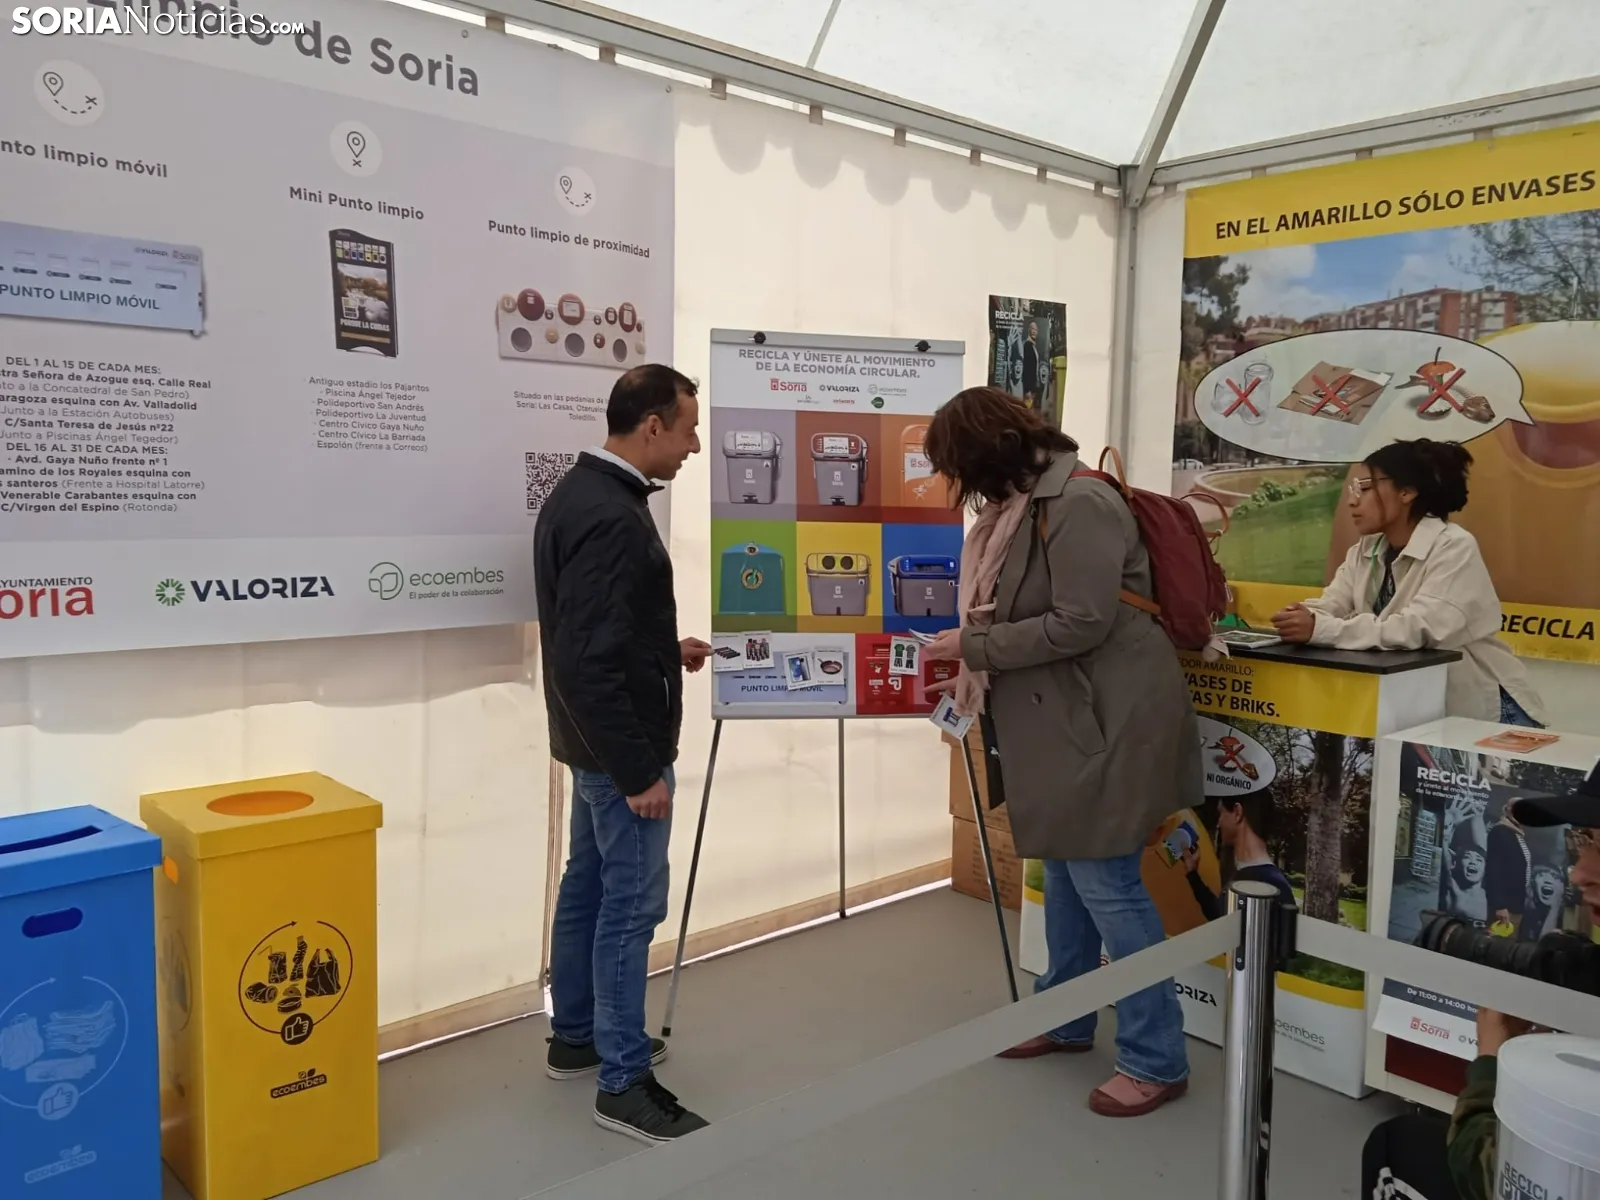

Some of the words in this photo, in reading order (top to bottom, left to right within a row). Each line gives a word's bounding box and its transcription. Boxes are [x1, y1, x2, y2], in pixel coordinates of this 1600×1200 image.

[295, 20, 351, 65] de
[370, 37, 479, 96] Soria
[1, 140, 36, 156] nto
[44, 145, 108, 168] limpio
[116, 158, 168, 178] móvil
[290, 187, 322, 203] Mini
[328, 193, 373, 211] Punto
[378, 201, 424, 220] limpio
[1216, 220, 1241, 239] EN
[1247, 217, 1270, 234] EL
[1275, 200, 1391, 231] AMARILLO
[1398, 189, 1464, 215] SÓLO
[1472, 169, 1596, 205] ENVASES
[488, 220, 526, 236] Punto
[530, 227, 570, 243] limpio
[574, 234, 589, 245] de
[593, 238, 650, 258] proximidad
[0, 284, 54, 300] PUNTO
[60, 290, 111, 305] LIMPIO
[116, 294, 160, 310] MÓVIL
[995, 310, 1024, 321] RECICLA
[6, 357, 30, 366] DEL
[44, 360, 59, 368] AL
[63, 360, 74, 368] 15
[79, 361, 94, 370] DE
[99, 363, 131, 372] CADA
[135, 365, 161, 374] MES:
[739, 349, 789, 360] RECICLA
[793, 352, 800, 360] Y
[804, 351, 842, 363] ÚNETE
[845, 355, 860, 364] AL
[864, 356, 935, 367] MOVIMIENTO
[756, 362, 772, 371] DE
[775, 363, 790, 372] LA
[794, 364, 856, 375] ECONOMÍA
[860, 367, 920, 378] CIRCULAR.
[22, 370, 64, 380] Señora
[68, 373, 82, 381] de
[86, 374, 128, 384] Azogue
[132, 378, 154, 386] esq.
[158, 378, 185, 387] Calle
[189, 380, 211, 388] Real
[309, 377, 344, 387] Antiguo
[347, 380, 378, 388] estadio
[380, 381, 392, 389] los
[780, 382, 807, 392] Soria
[29, 382, 39, 391] la
[43, 383, 110, 395] Concatedral
[131, 388, 150, 396] San
[155, 389, 189, 399] Pedro)
[325, 389, 355, 397] Piscina
[386, 392, 415, 401] Tejedor
[51, 397, 95, 405] esquina
[144, 400, 197, 410] Valladolid
[317, 398, 375, 408] Polideportivo
[378, 402, 393, 410] San
[395, 403, 424, 411] Andrés
[1, 406, 34, 415] Junto
[49, 408, 58, 416] la
[62, 408, 109, 418] Estación
[113, 410, 174, 421] Autobuses)
[316, 409, 373, 419] Polideportivo
[389, 413, 426, 421] Juventud
[5, 418, 53, 428] C/Santa
[57, 420, 94, 429] Teresa
[98, 422, 112, 430] de
[116, 422, 146, 431] Jesús
[319, 420, 348, 428] Centro
[380, 423, 400, 431] Gaya
[47, 431, 91, 440] Piscinas
[131, 434, 178, 444] Tegedor)
[318, 430, 348, 438] Centro
[6, 443, 31, 451] DEL
[51, 444, 67, 452] AL
[70, 444, 81, 452] 31
[106, 445, 138, 453] CADA
[142, 446, 168, 454] MES:
[317, 441, 352, 449] Espolón
[355, 442, 384, 450] (frente
[15, 455, 41, 464] Avd.
[46, 456, 75, 465] Gaya
[79, 456, 108, 464] Nuño
[112, 457, 145, 465] frente
[40, 467, 54, 475] de
[79, 468, 122, 477] Royales
[126, 469, 168, 478] esquina
[62, 480, 103, 488] (Frente
[116, 481, 160, 489] Hospital
[164, 481, 205, 490] Latorre)
[0, 491, 60, 499] Venerable
[65, 492, 128, 500] Carabantes
[132, 492, 174, 500] esquina
[1, 503, 55, 512] C/Virgen
[60, 503, 77, 511] del
[82, 504, 119, 512] Espino
[123, 503, 177, 512] (Rotonda)
[0, 577, 93, 588] YUNTAMIENTO
[410, 567, 504, 586] ecoembes
[191, 576, 335, 602] VALORIZA
[418, 591, 439, 599] poder
[442, 589, 450, 597] de
[452, 589, 458, 597] la
[461, 588, 503, 596] colaboración
[0, 587, 94, 619] oria
[1500, 614, 1594, 640] RECICLA
[1204, 661, 1254, 676] AMARILLO:
[1185, 673, 1226, 690] ASES
[1232, 679, 1252, 694] DE
[1190, 690, 1212, 705] AS
[1216, 695, 1226, 707] Y
[1230, 697, 1280, 717] BRIKS.
[1207, 773, 1214, 782] NI
[1216, 774, 1251, 790] ORGÁNICO
[1417, 767, 1492, 791] RECICLA
[1175, 982, 1217, 1006] ORIZA
[1419, 991, 1437, 1000] 11:00
[1445, 999, 1466, 1009] 14:00
[1420, 1023, 1449, 1039] Soria
[273, 1075, 325, 1097] ecoembes
[1503, 1160, 1564, 1200] RECICL
